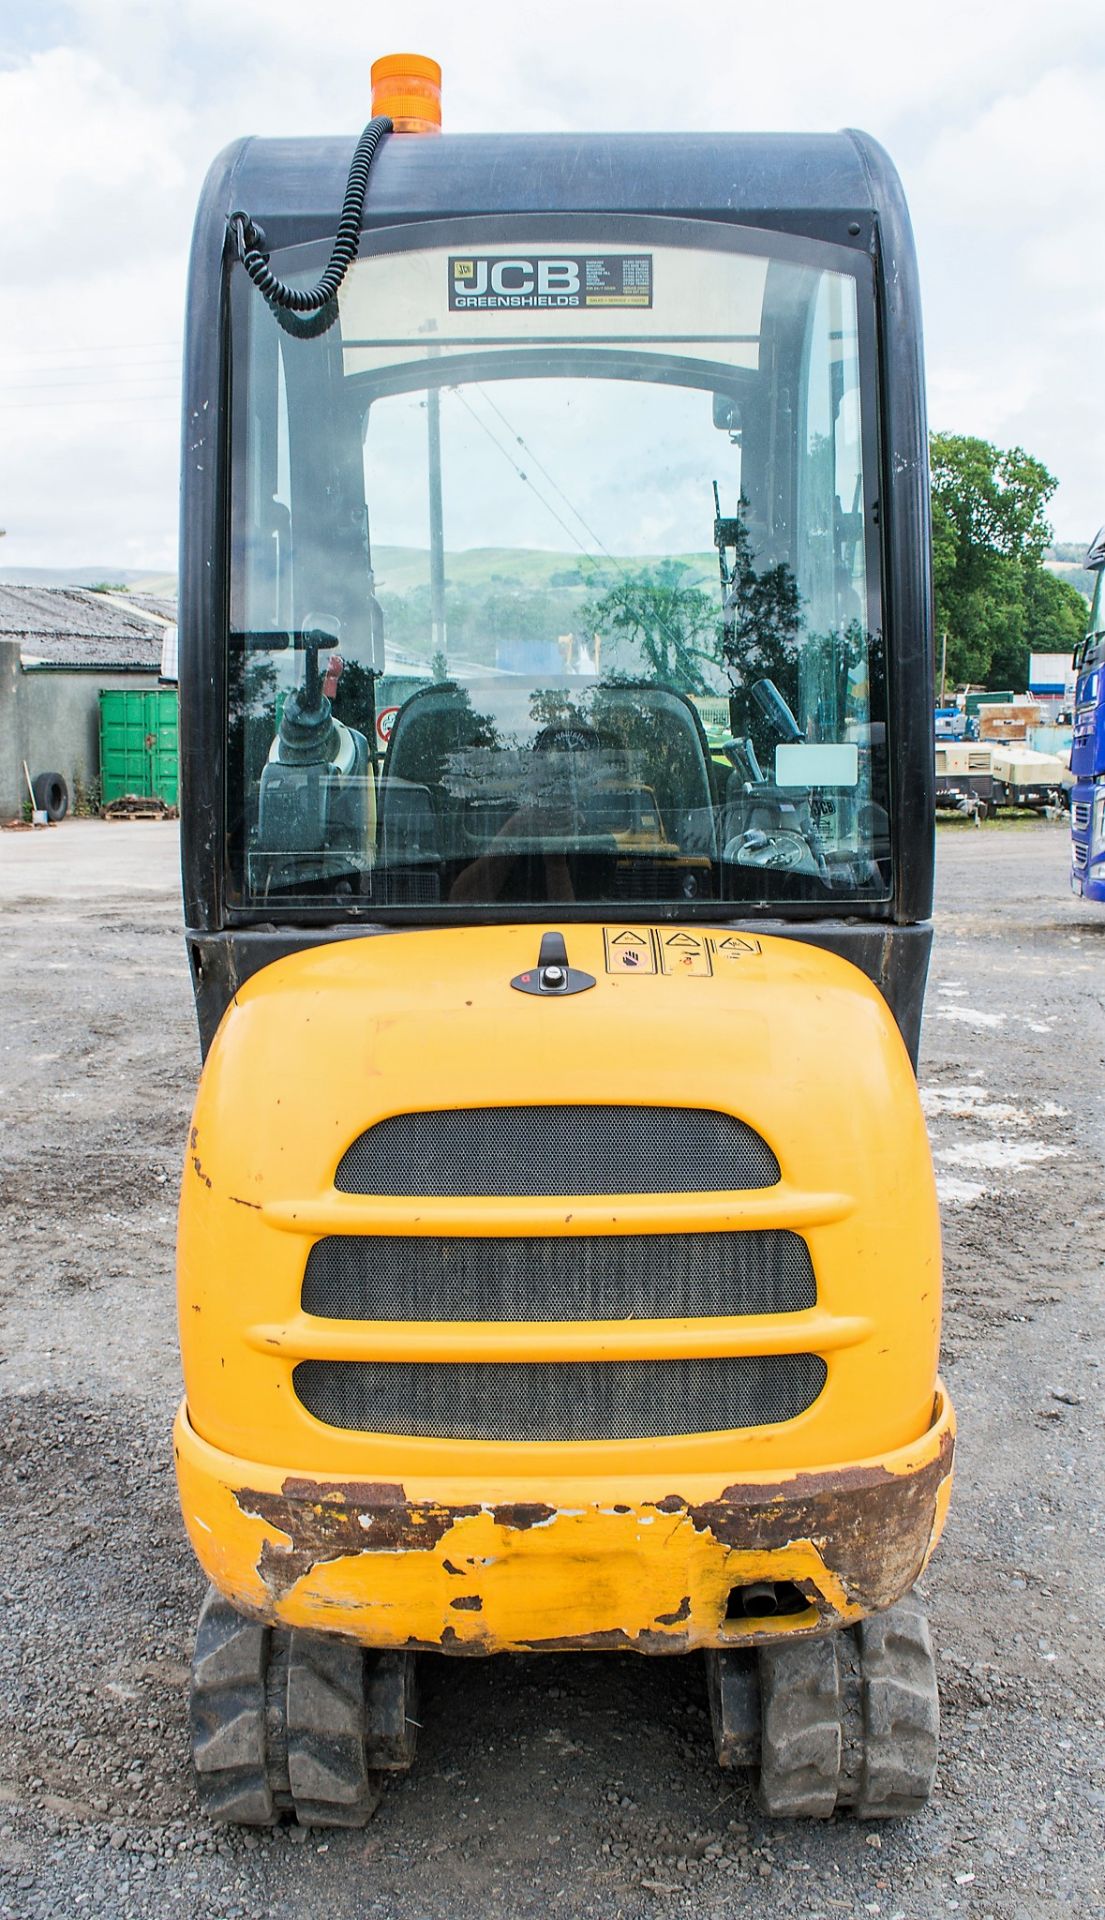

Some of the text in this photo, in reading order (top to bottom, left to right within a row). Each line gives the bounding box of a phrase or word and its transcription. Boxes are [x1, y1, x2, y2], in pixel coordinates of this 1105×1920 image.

[455, 260, 580, 295] JCB
[455, 296, 579, 307] GREENSHIELDS
[812, 799, 834, 816] JCB
